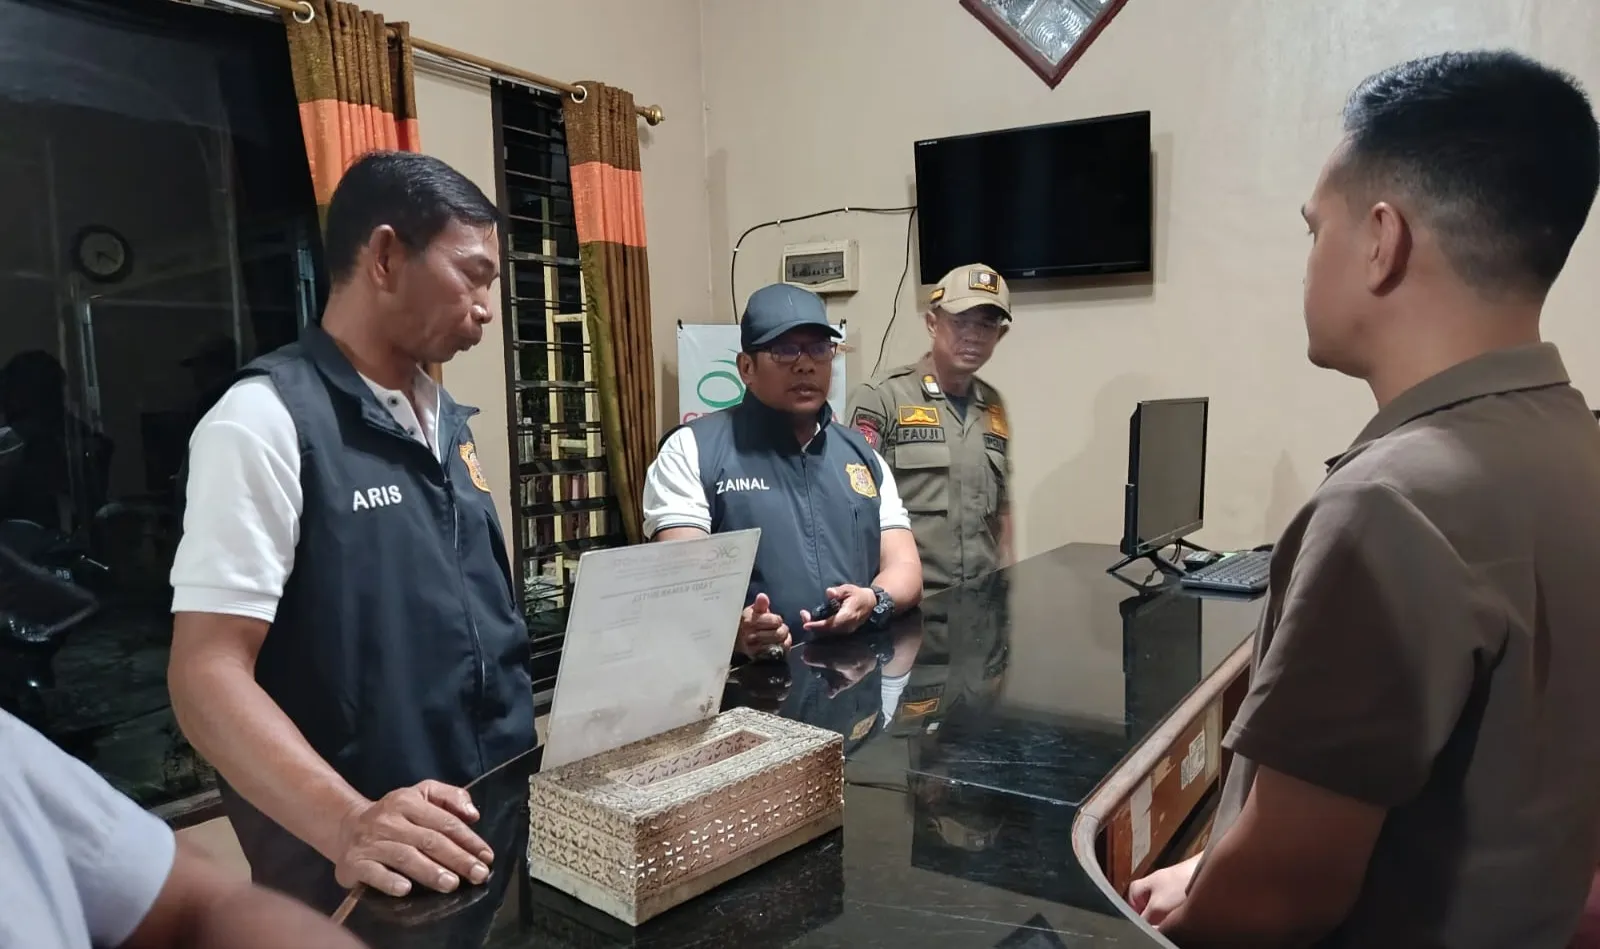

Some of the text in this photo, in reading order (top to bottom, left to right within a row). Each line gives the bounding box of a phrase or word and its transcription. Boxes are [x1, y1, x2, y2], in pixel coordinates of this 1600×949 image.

[903, 428, 939, 440] FAUJI
[716, 477, 770, 495] ZAINAL
[352, 484, 402, 511] ARIS
